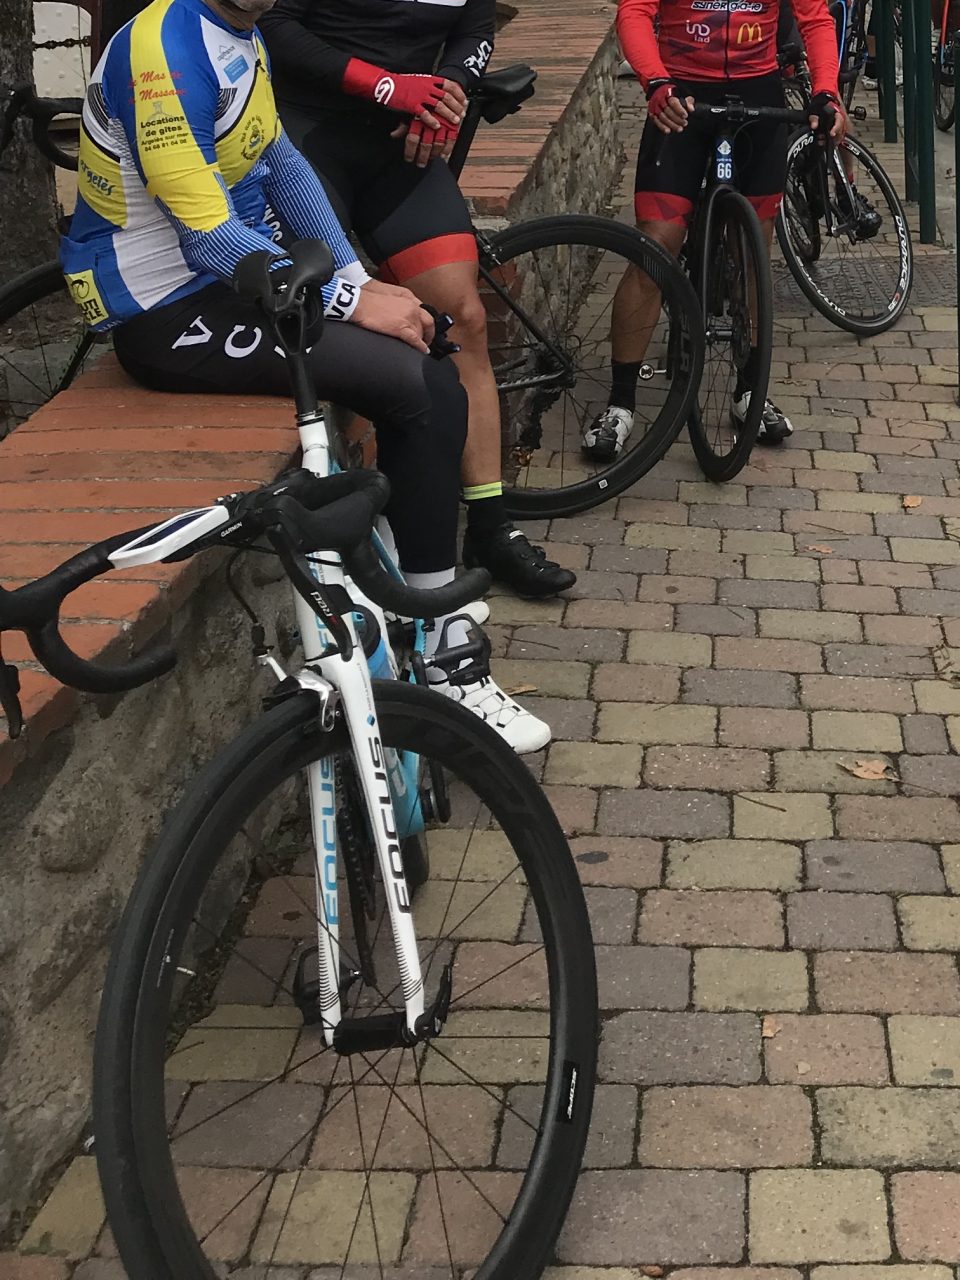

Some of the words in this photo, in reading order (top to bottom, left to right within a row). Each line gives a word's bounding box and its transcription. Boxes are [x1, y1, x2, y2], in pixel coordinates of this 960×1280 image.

[140, 70, 166, 83] Mas
[141, 115, 185, 129] Locations
[145, 129, 156, 138] de
[717, 162, 732, 179] 66
[325, 282, 356, 321] VCA
[220, 521, 243, 538] GARMIN
[368, 736, 412, 914] FOCUS
